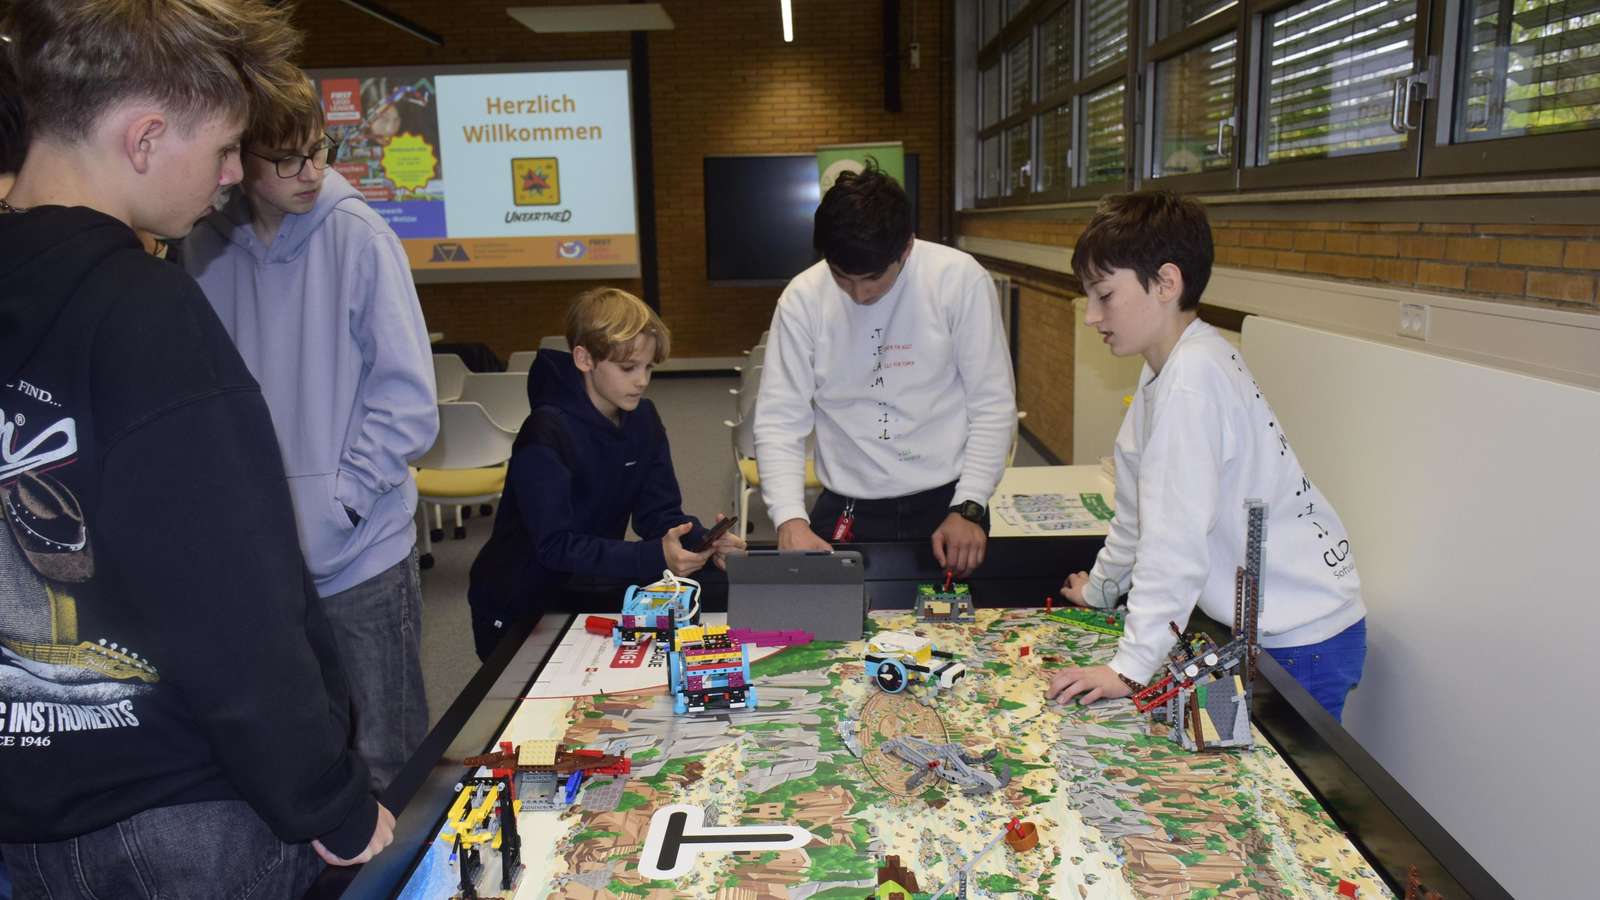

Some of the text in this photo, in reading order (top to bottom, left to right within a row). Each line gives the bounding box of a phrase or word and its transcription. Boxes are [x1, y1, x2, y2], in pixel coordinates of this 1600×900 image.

[486, 94, 577, 115] Herzlich
[463, 123, 603, 143] Willkommen
[9, 700, 140, 733] INSTRUMENTS
[20, 735, 52, 747] 1946
